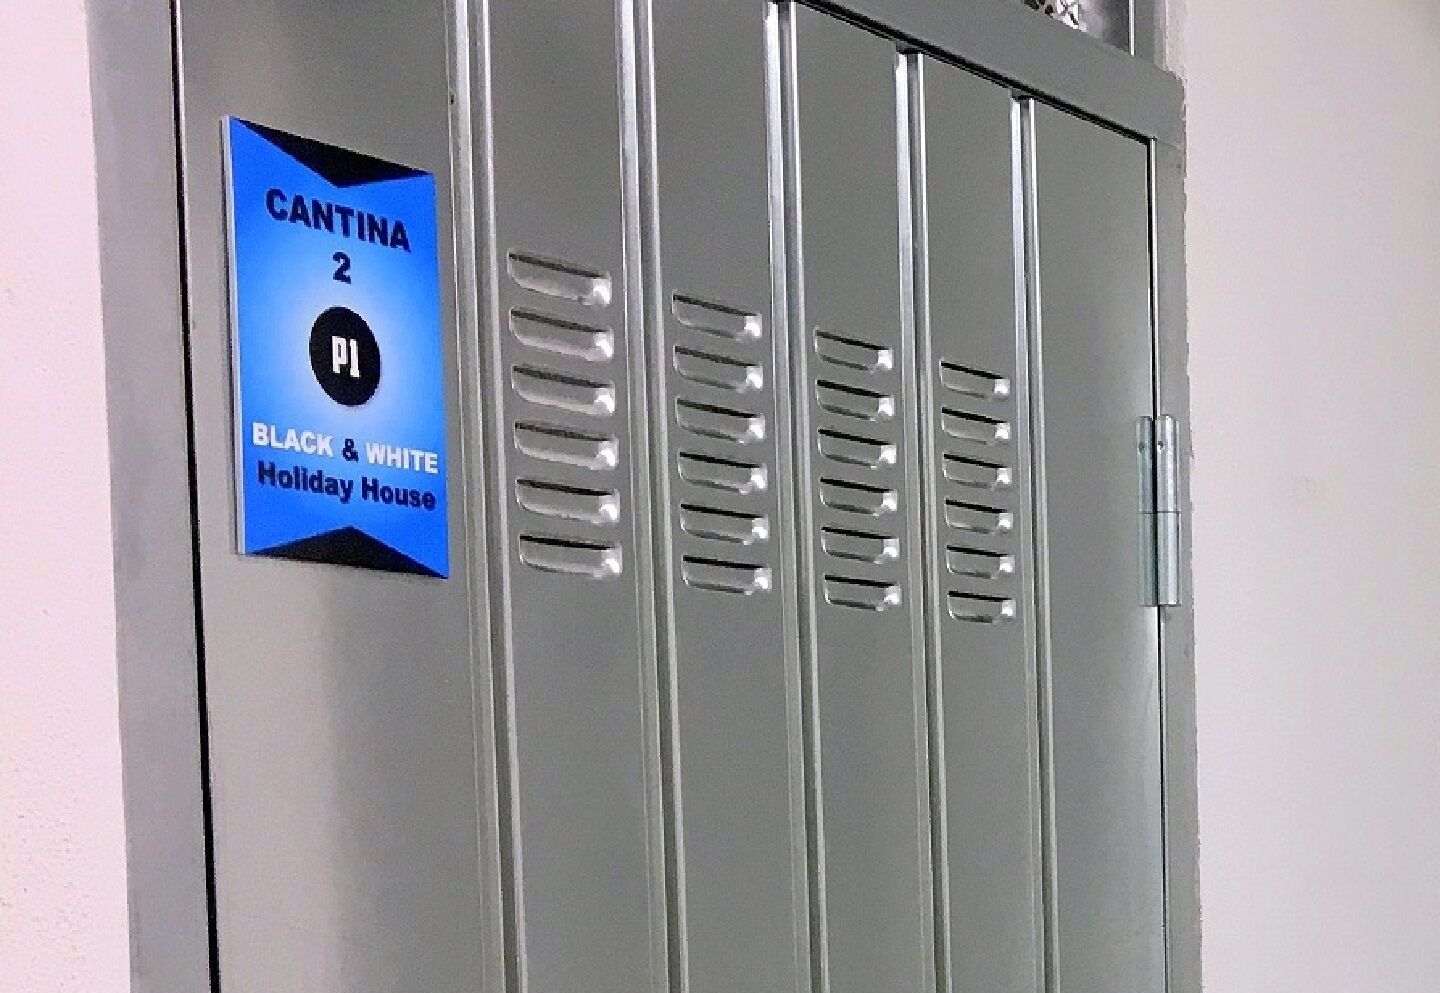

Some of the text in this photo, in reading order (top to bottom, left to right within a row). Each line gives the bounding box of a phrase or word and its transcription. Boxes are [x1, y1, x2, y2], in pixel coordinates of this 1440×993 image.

[266, 188, 411, 253] CANTINA
[332, 252, 352, 284] 2
[332, 336, 361, 378] P1
[252, 422, 439, 474] BLACK & WHITE
[257, 461, 438, 511] Holiday House
